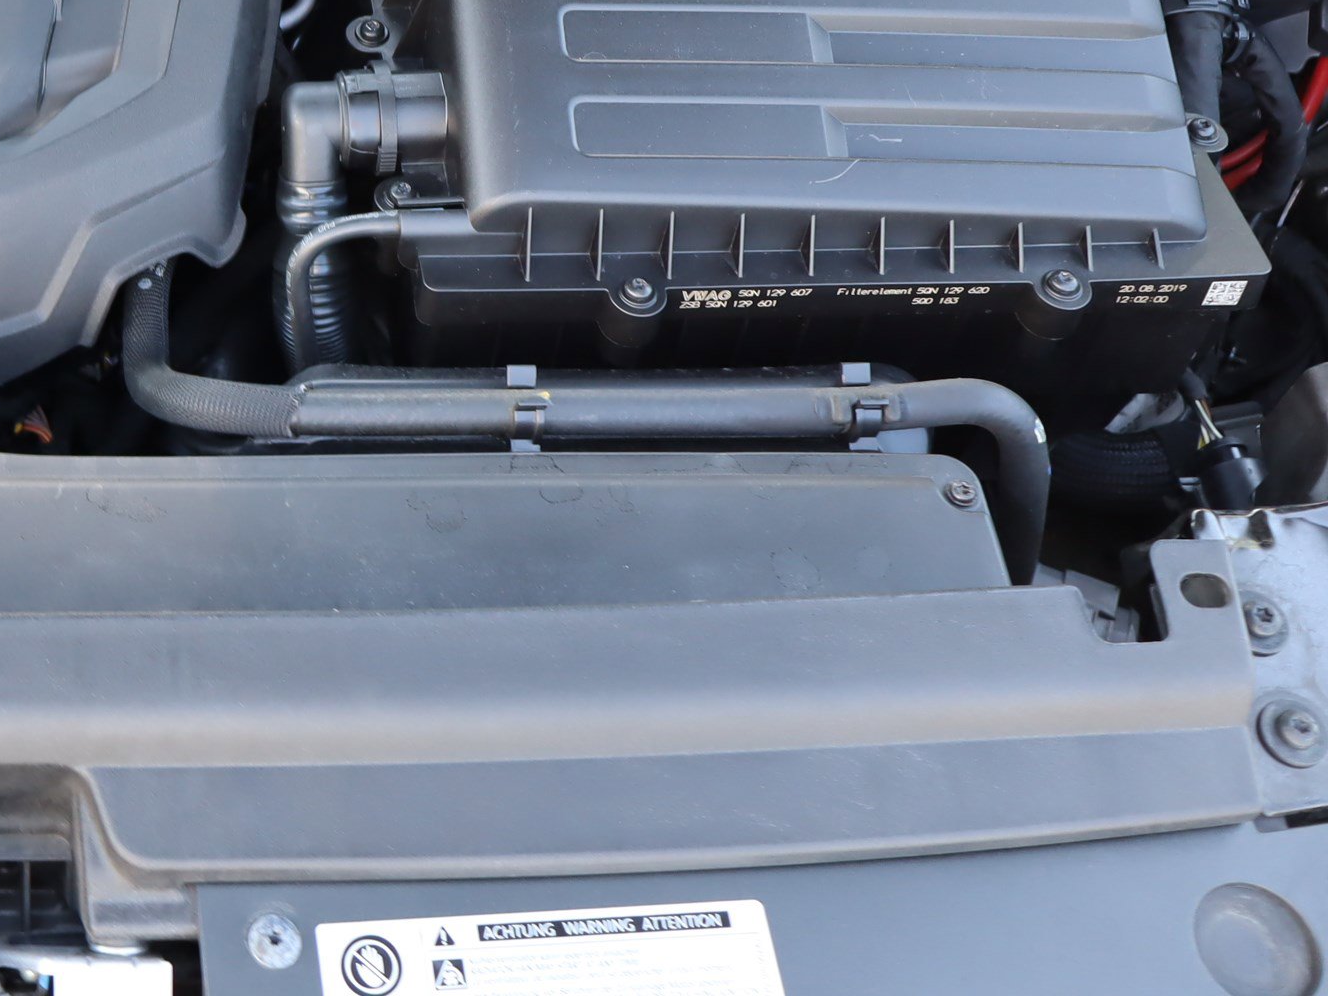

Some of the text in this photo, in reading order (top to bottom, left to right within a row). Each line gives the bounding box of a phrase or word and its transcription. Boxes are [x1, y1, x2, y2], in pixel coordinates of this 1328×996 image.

[682, 290, 732, 301] VWAG
[766, 288, 786, 297] 129
[790, 288, 813, 296] 607
[837, 287, 913, 295] Filterelement
[967, 286, 990, 294] 620
[1118, 284, 1188, 293] 20.08.2019
[1115, 295, 1170, 304] 12:02:00
[482, 912, 722, 940] ACHTUNG WARNING ATTENTION
